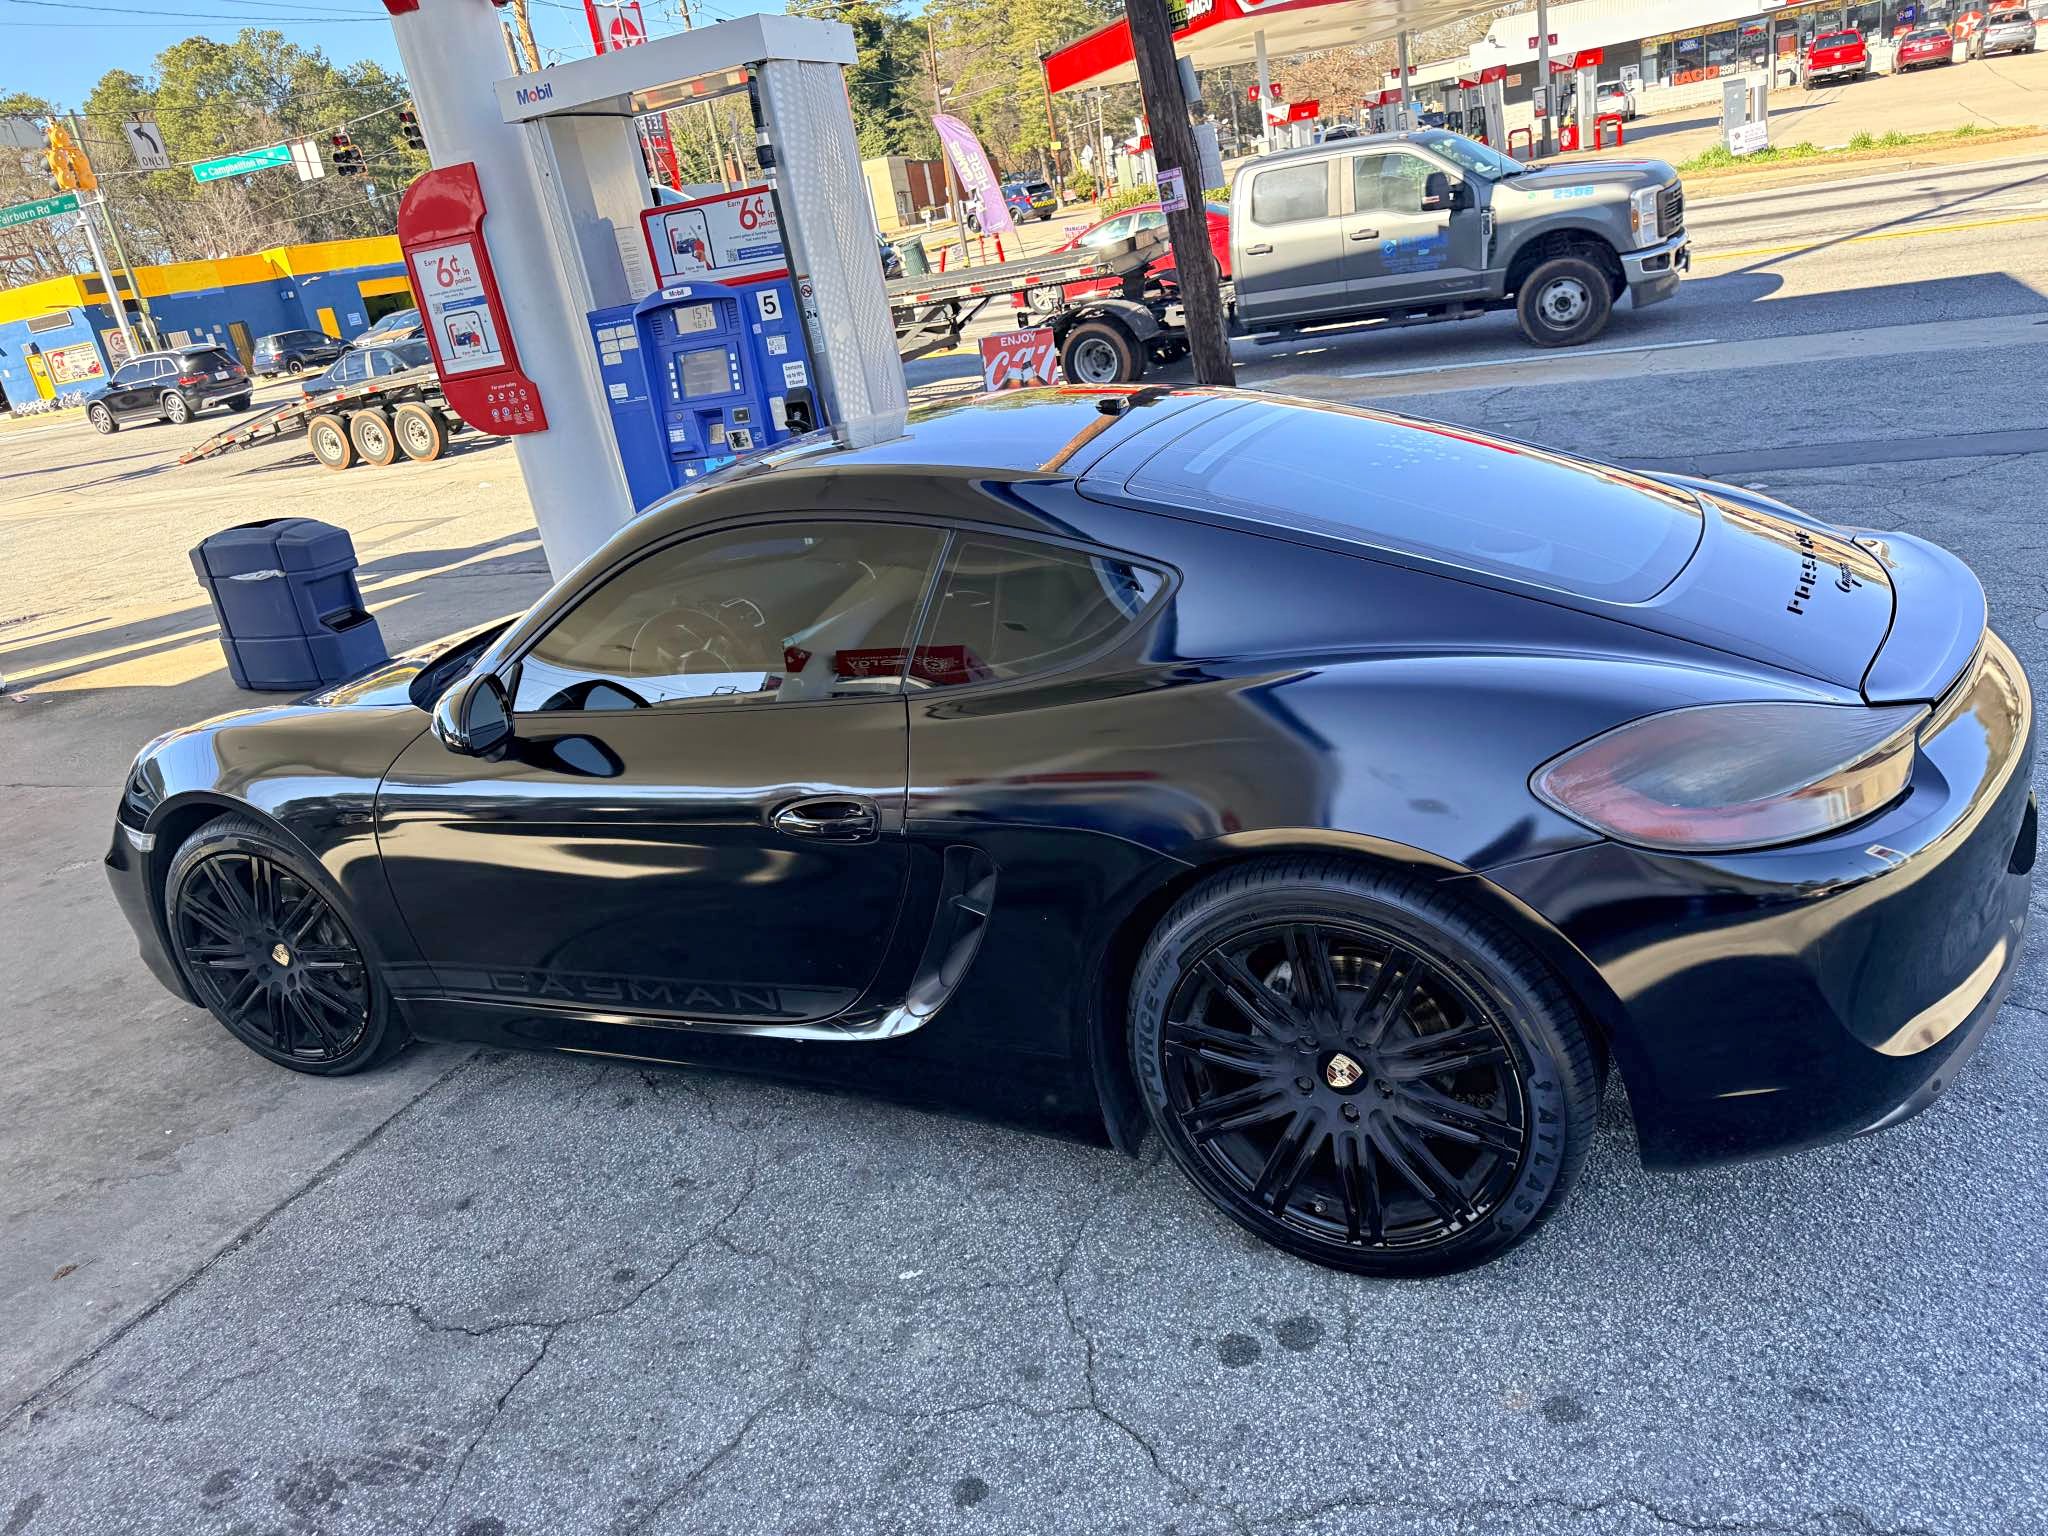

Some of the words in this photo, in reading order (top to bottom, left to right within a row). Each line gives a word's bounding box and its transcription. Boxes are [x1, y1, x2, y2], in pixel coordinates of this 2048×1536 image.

[516, 82, 553, 106] Mobil
[141, 156, 165, 167] ONLY
[966, 151, 992, 192] HERE
[727, 200, 741, 208] Earn
[0, 206, 36, 224] airburn
[36, 204, 50, 216] Rd
[767, 210, 776, 219] in
[758, 219, 777, 229] points
[424, 259, 437, 267] Earn
[462, 267, 470, 276] in
[455, 276, 472, 286] points
[668, 289, 685, 297] Mobil
[763, 295, 777, 315] 5
[1000, 331, 1037, 347] ENJOY
[1786, 531, 1817, 615] PORSCHE
[488, 970, 778, 1012] CAYMAN
[1513, 1106, 1559, 1216] ATLAS
